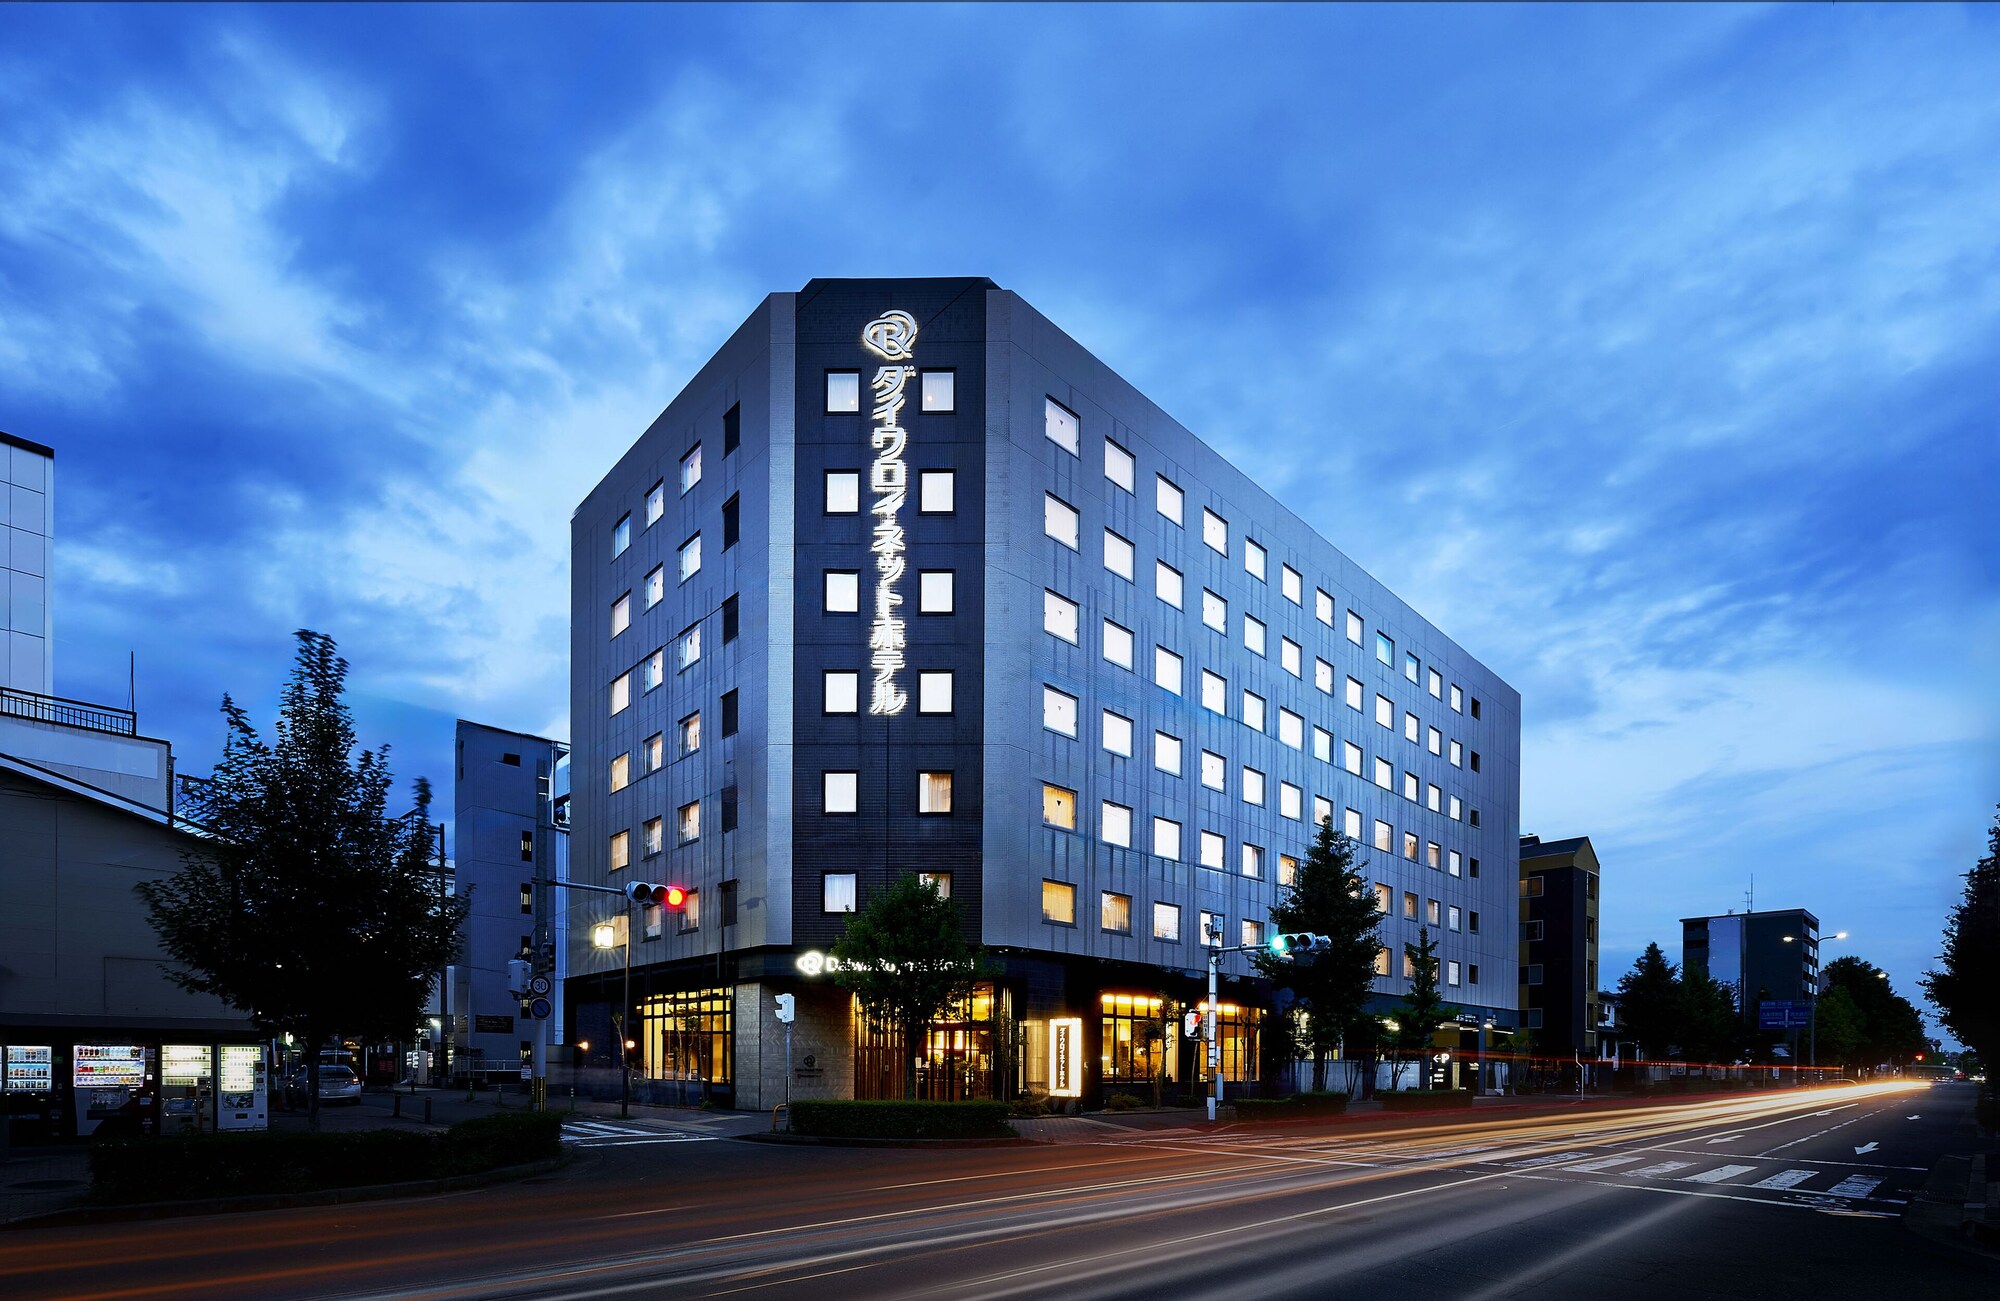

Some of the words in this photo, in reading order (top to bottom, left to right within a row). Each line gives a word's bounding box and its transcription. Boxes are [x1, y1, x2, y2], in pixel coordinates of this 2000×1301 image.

[871, 365, 916, 716] ダイワロイネットホテル
[535, 981, 546, 991] 30
[1441, 1053, 1450, 1063] P
